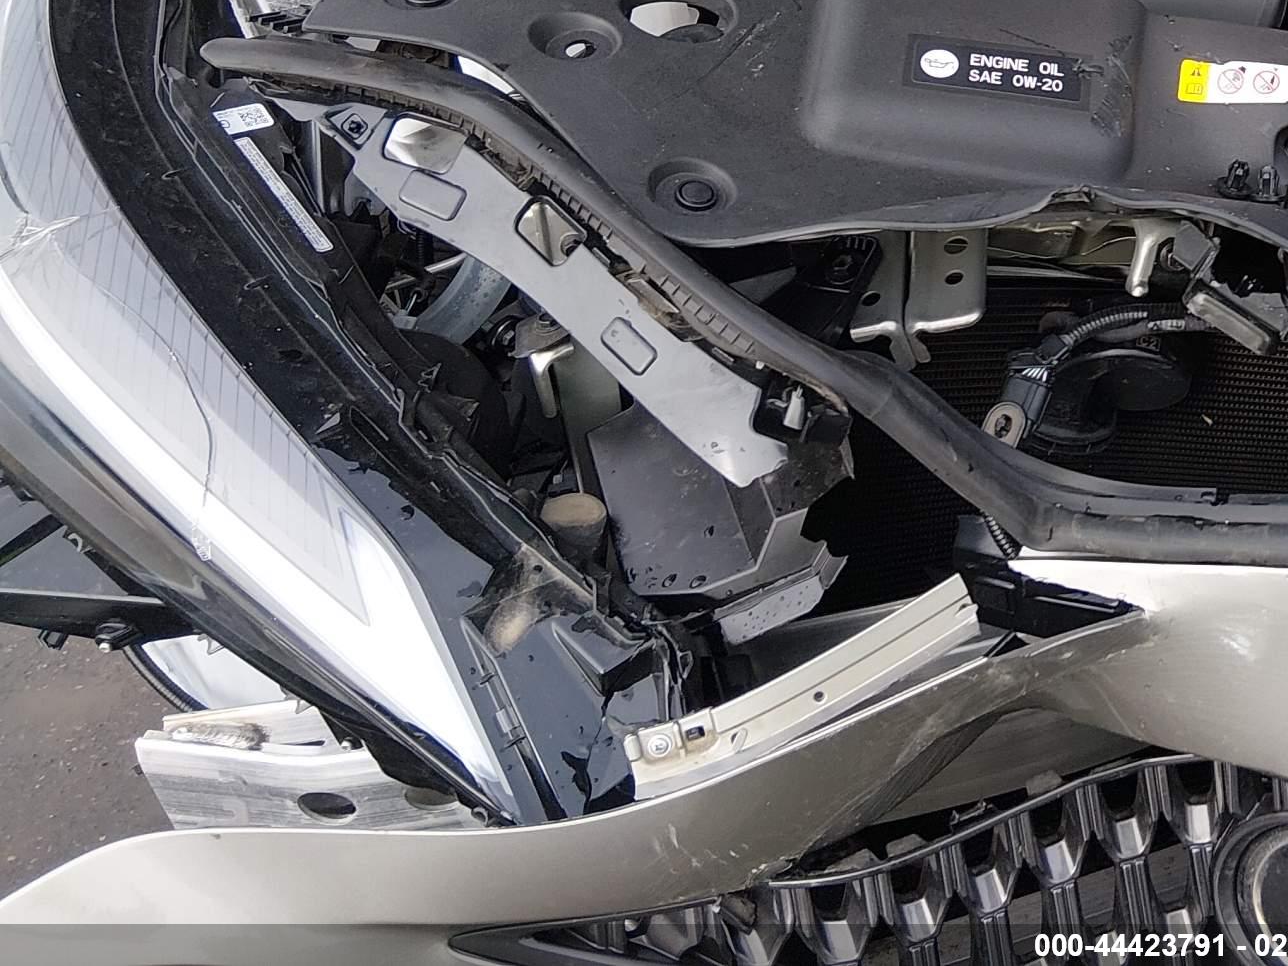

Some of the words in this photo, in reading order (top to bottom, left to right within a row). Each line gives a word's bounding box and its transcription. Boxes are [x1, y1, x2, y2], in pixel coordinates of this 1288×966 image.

[969, 53, 1029, 73] ENGINE
[1038, 62, 1065, 77] OIL
[968, 69, 1003, 85] SAE
[1012, 74, 1064, 93] 0W-20
